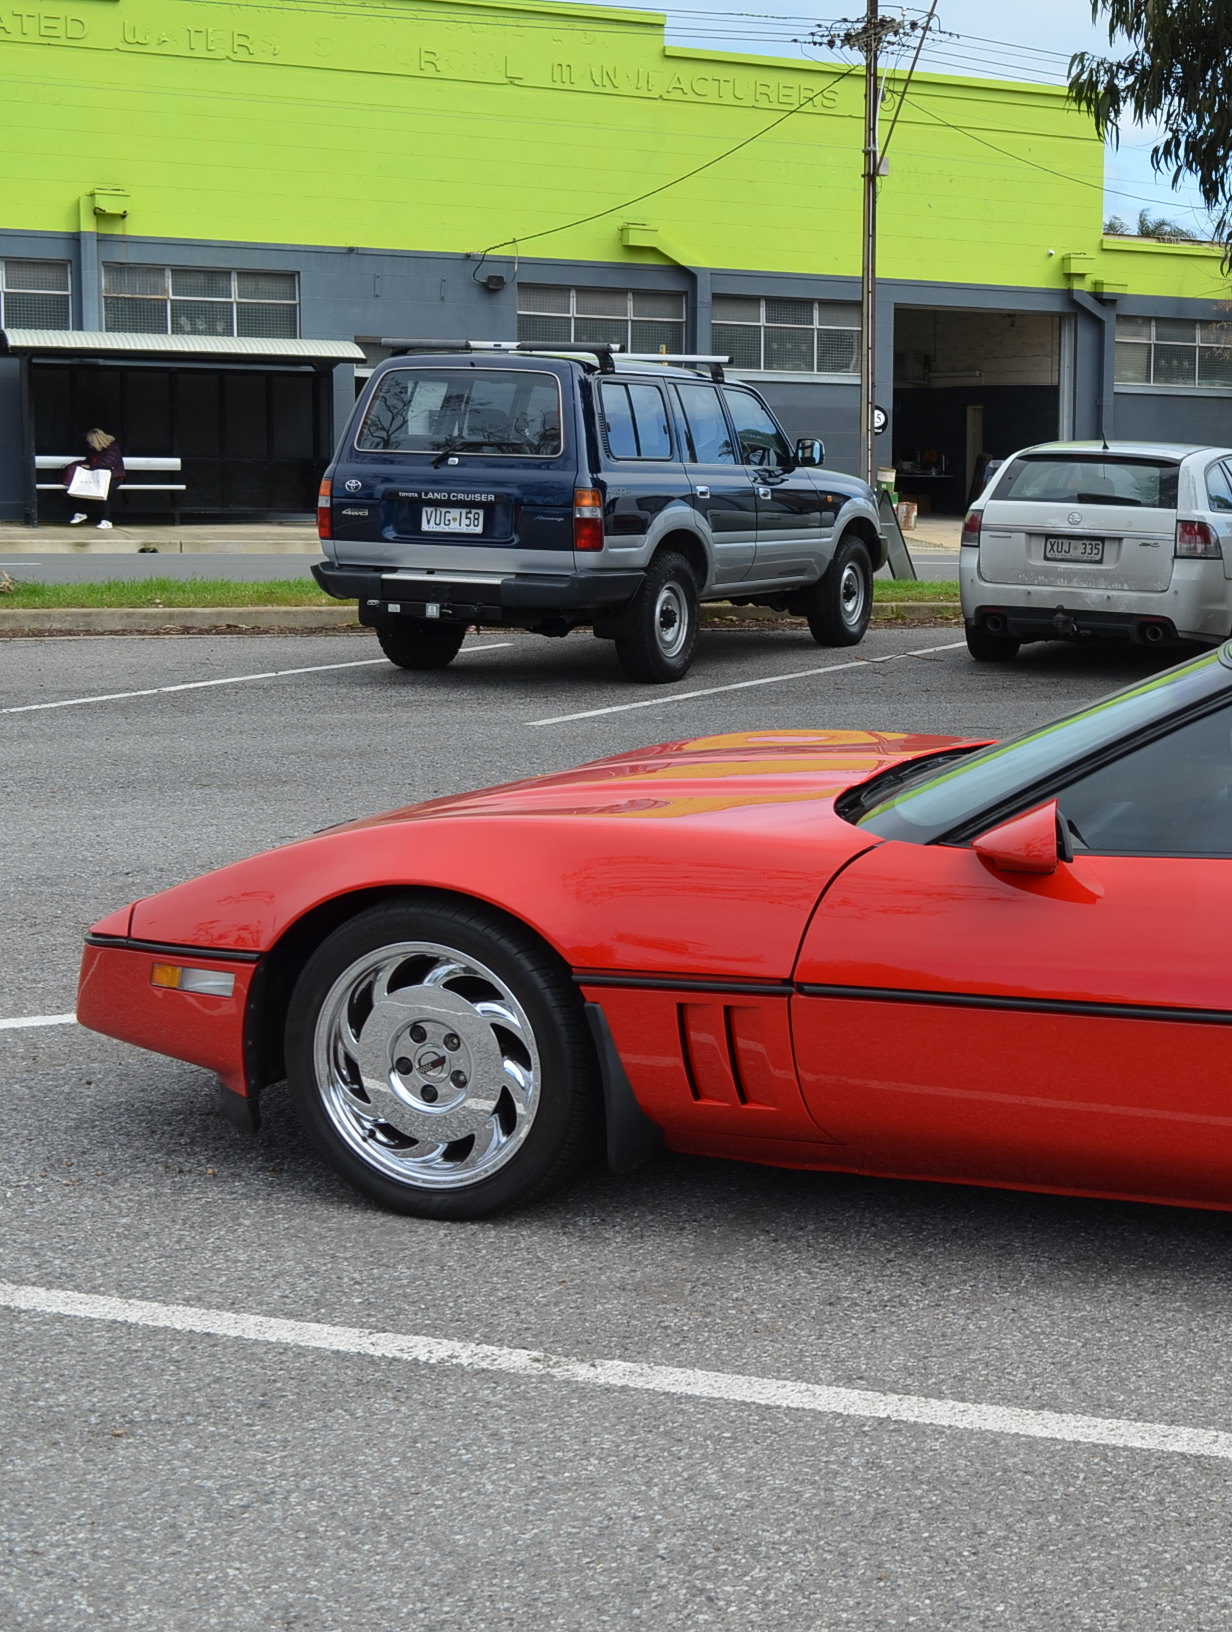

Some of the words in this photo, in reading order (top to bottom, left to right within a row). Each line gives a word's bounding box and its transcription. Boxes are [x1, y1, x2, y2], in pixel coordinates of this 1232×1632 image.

[421, 491, 448, 500] LAND
[450, 492, 495, 502] CRUISER
[425, 509, 452, 527] VUG
[458, 510, 480, 528] 158
[1048, 540, 1072, 554] XUJ
[1080, 542, 1101, 556] 335
